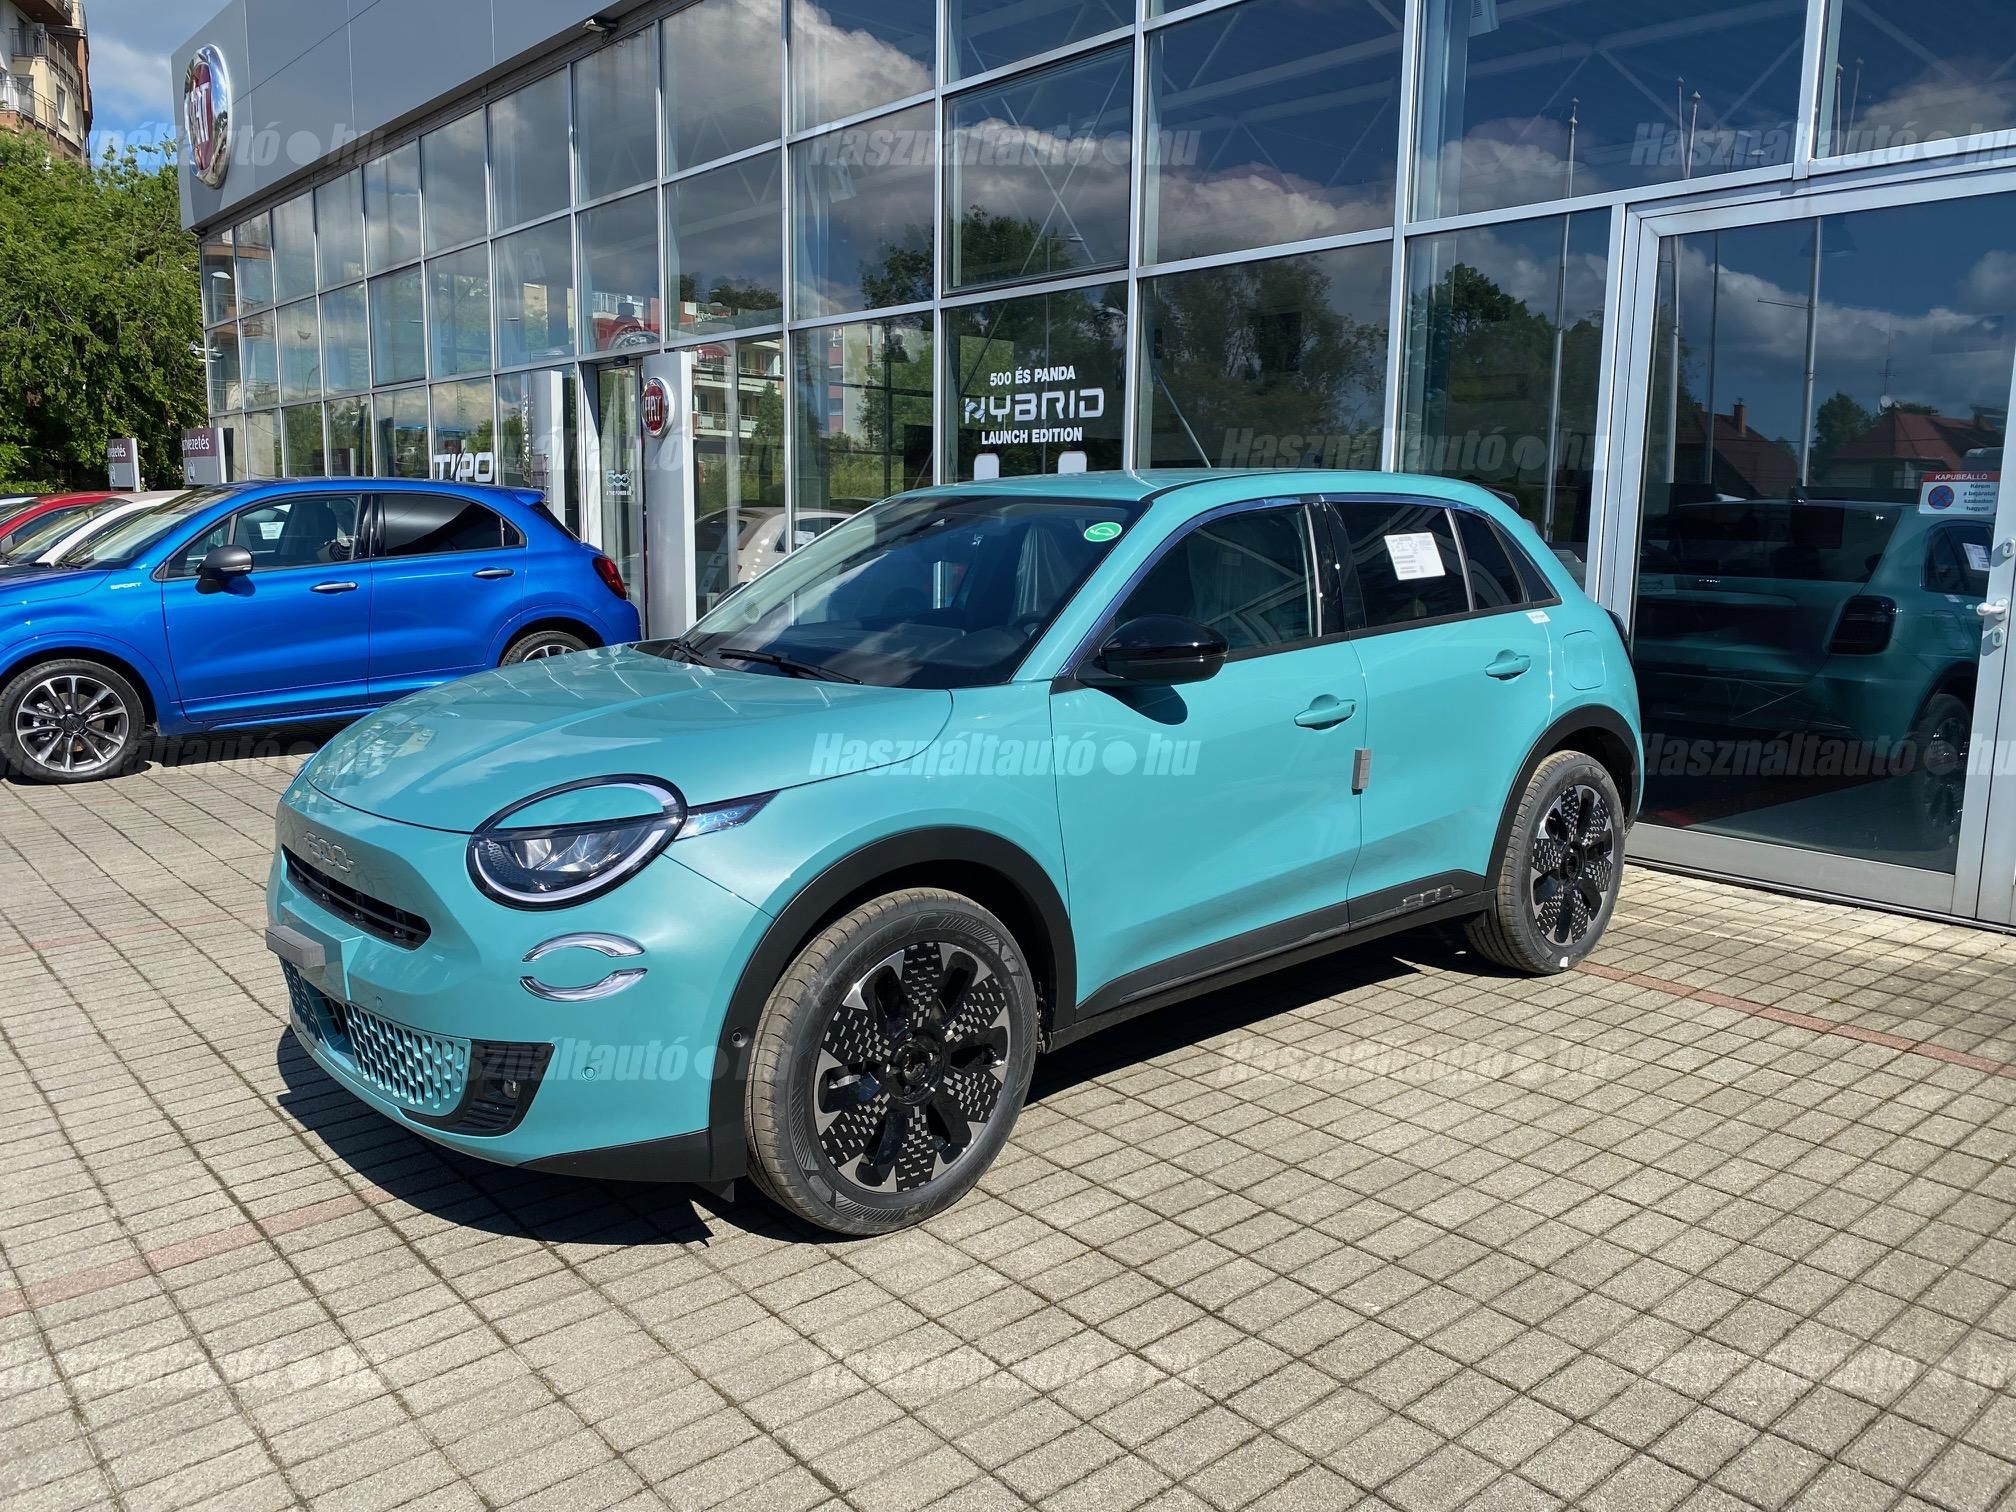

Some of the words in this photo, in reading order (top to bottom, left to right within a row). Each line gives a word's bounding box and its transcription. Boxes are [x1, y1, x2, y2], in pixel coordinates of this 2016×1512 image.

[989, 372, 1012, 387] 500
[1015, 366, 1031, 384] ÉS
[1034, 365, 1076, 383] PANDA
[965, 387, 1105, 424] HYBRID
[981, 429, 1028, 445] LAUNCH
[1032, 427, 1083, 443] EDITION
